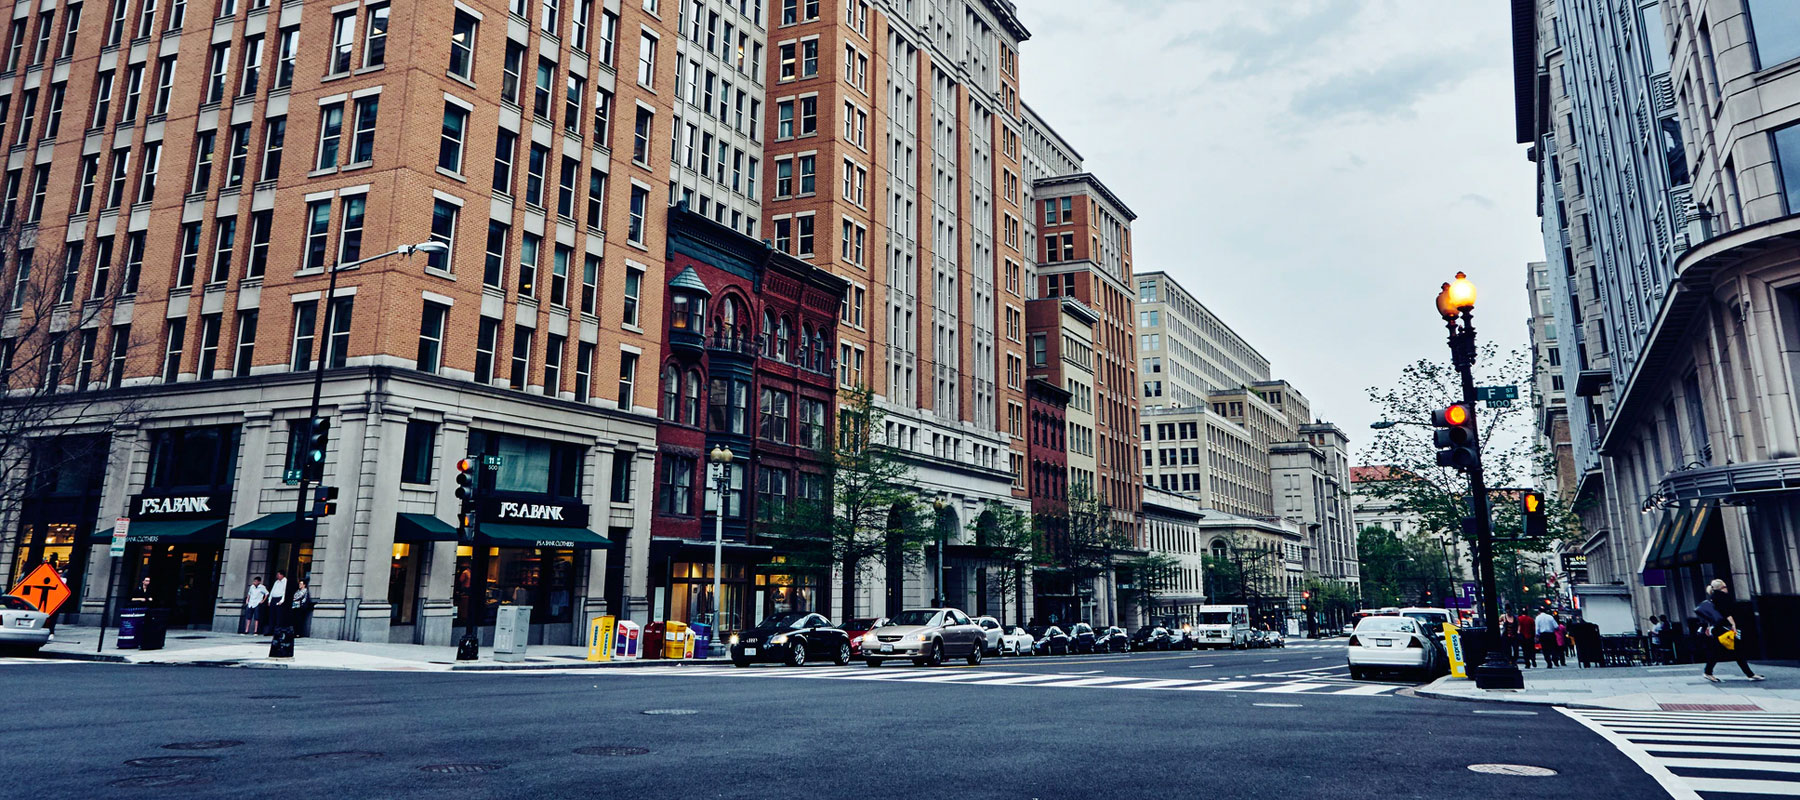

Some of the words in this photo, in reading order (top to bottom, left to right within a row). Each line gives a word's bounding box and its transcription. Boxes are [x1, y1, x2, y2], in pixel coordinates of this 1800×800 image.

[1487, 388, 1496, 399] F
[1487, 400, 1510, 408] 1100
[287, 470, 293, 479] F
[1451, 634, 1461, 662] express
